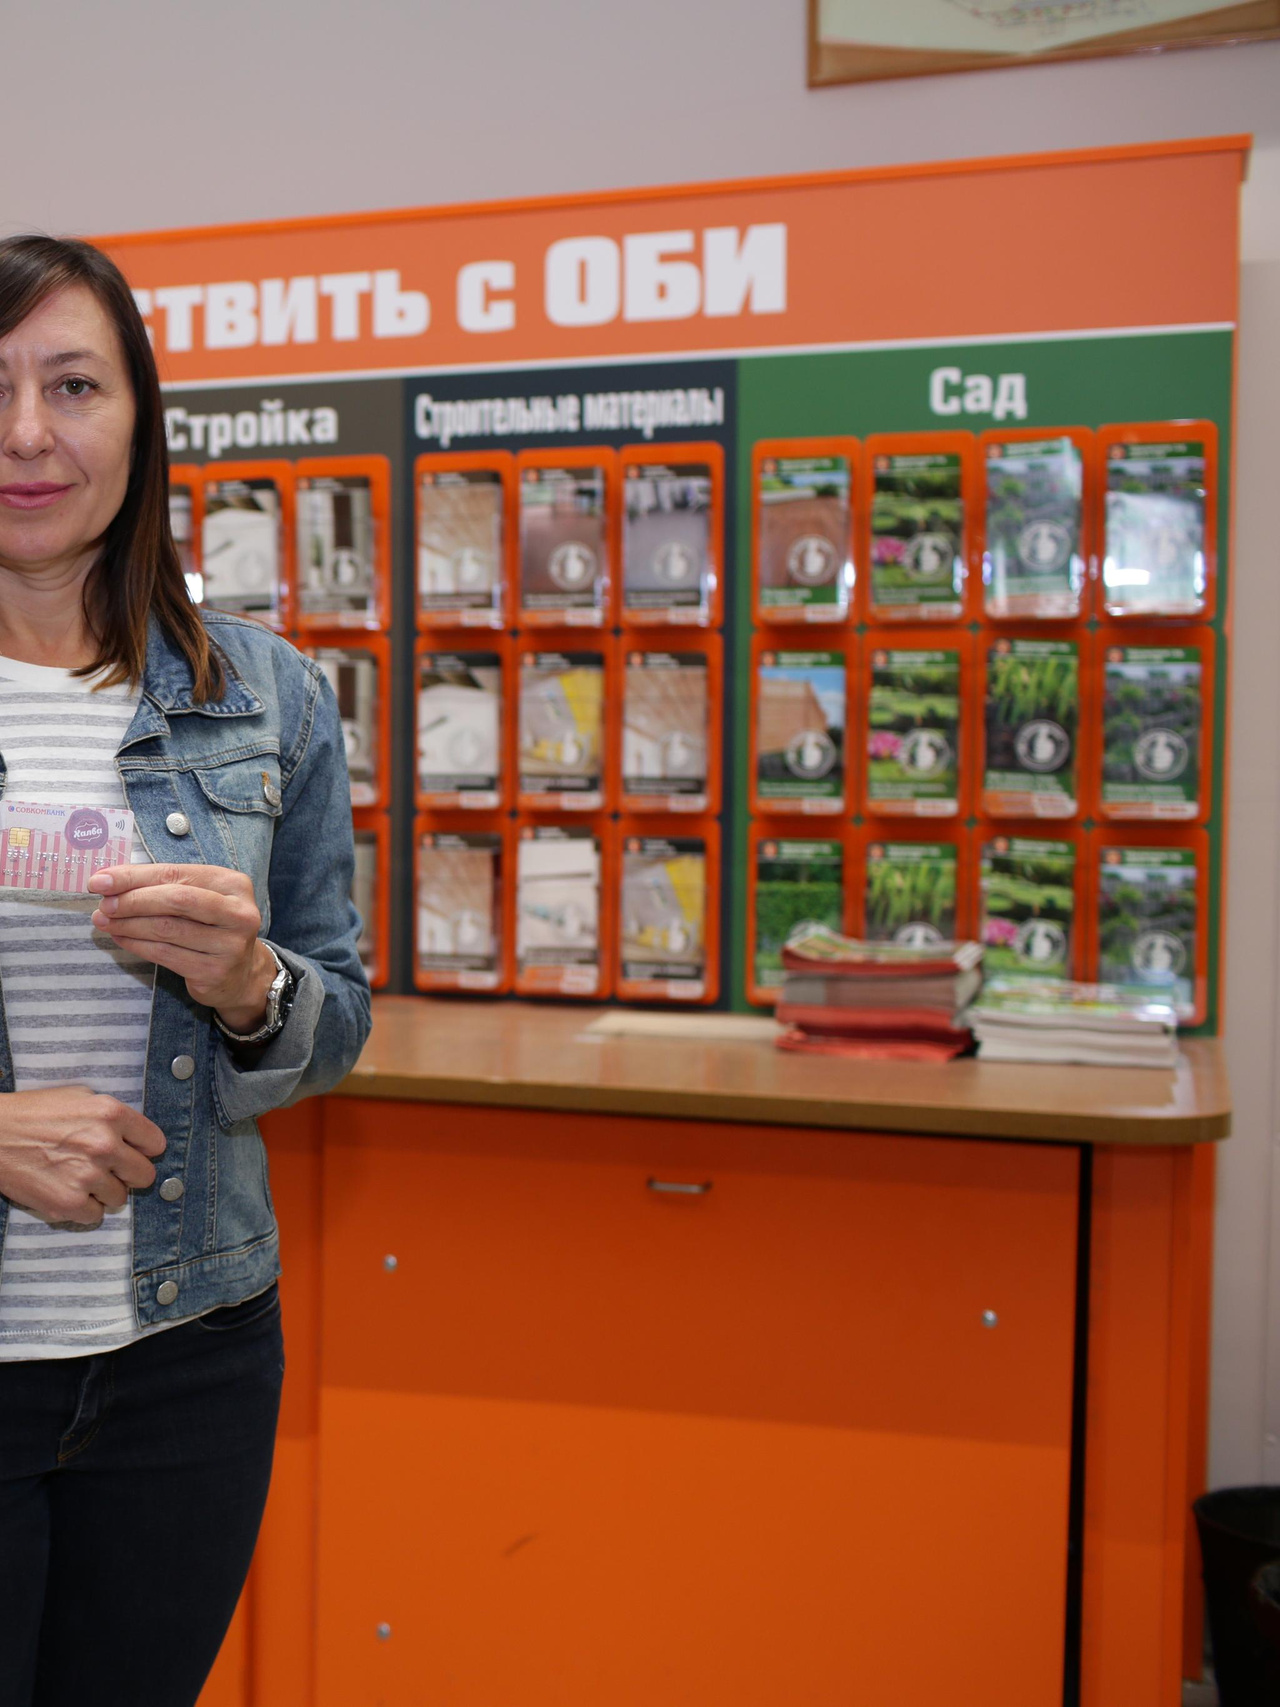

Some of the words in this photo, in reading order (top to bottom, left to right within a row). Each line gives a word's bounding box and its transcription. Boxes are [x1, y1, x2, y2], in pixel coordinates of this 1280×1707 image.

[456, 260, 516, 332] с
[544, 222, 787, 328] ОБИ
[414, 393, 580, 449] Строительные
[583, 387, 724, 439] материалы
[929, 367, 1029, 420] Сад
[166, 399, 339, 458] Стройка
[15, 806, 66, 817] СОВКОМБАНК
[73, 827, 103, 839] Халва
